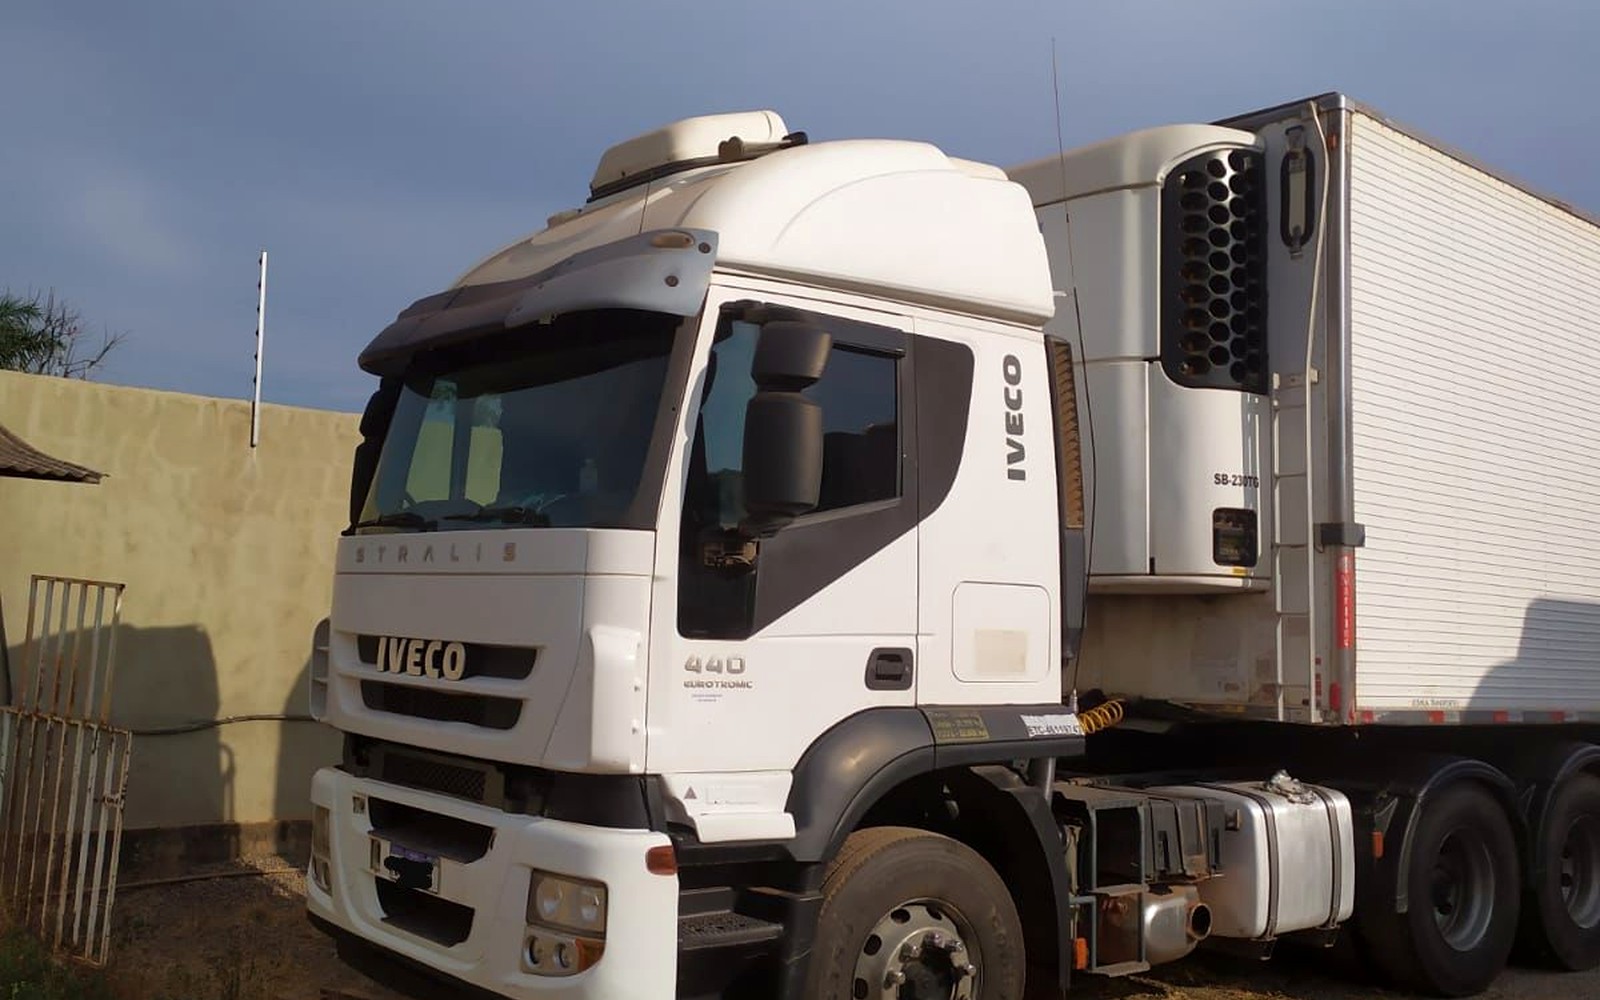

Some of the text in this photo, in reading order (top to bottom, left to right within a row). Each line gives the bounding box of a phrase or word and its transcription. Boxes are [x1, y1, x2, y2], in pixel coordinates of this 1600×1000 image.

[1003, 354, 1026, 481] IVECO
[355, 542, 517, 564] STRALIS
[376, 636, 467, 681] IVECO
[685, 656, 746, 674] 440
